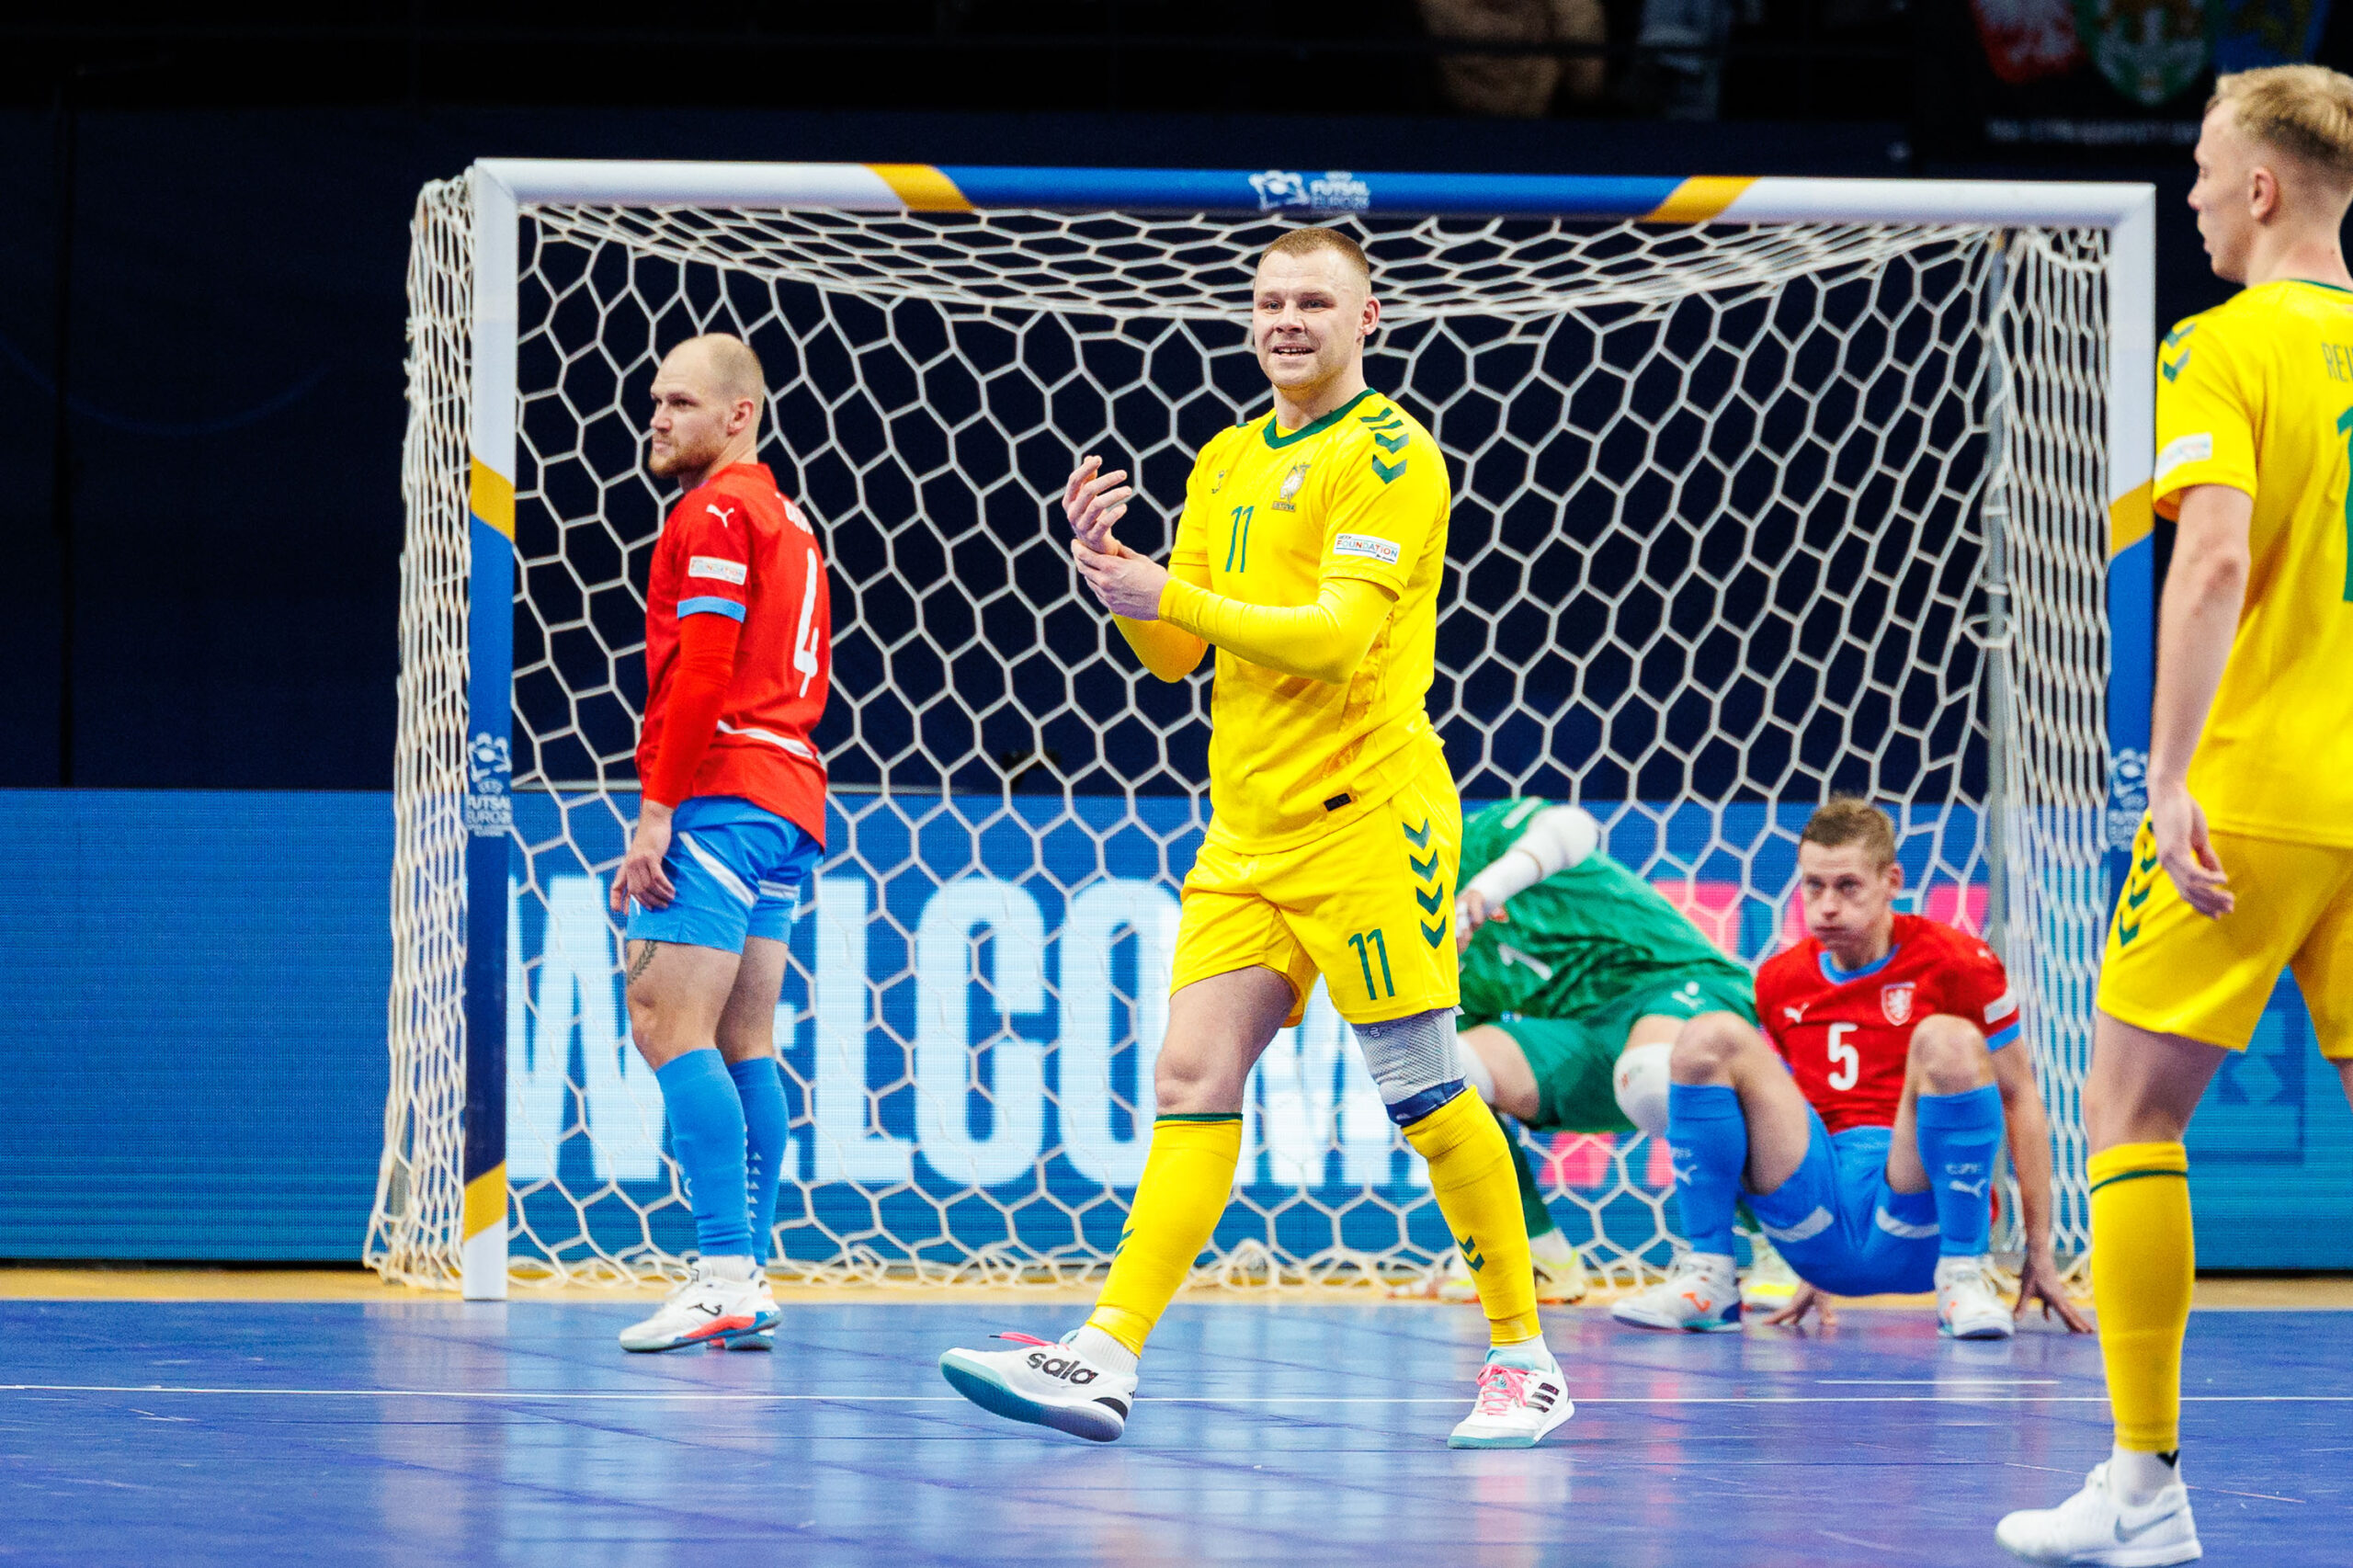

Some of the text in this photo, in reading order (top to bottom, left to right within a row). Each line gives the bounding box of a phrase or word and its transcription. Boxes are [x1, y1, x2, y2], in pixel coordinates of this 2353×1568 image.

[1225, 506, 1255, 573] 11
[1336, 539, 1398, 558] FOUNDATION
[793, 547, 819, 699] 4
[1348, 928, 1395, 1000] 11
[1827, 1022, 1859, 1091] 5
[1027, 1352, 1099, 1385] sala
